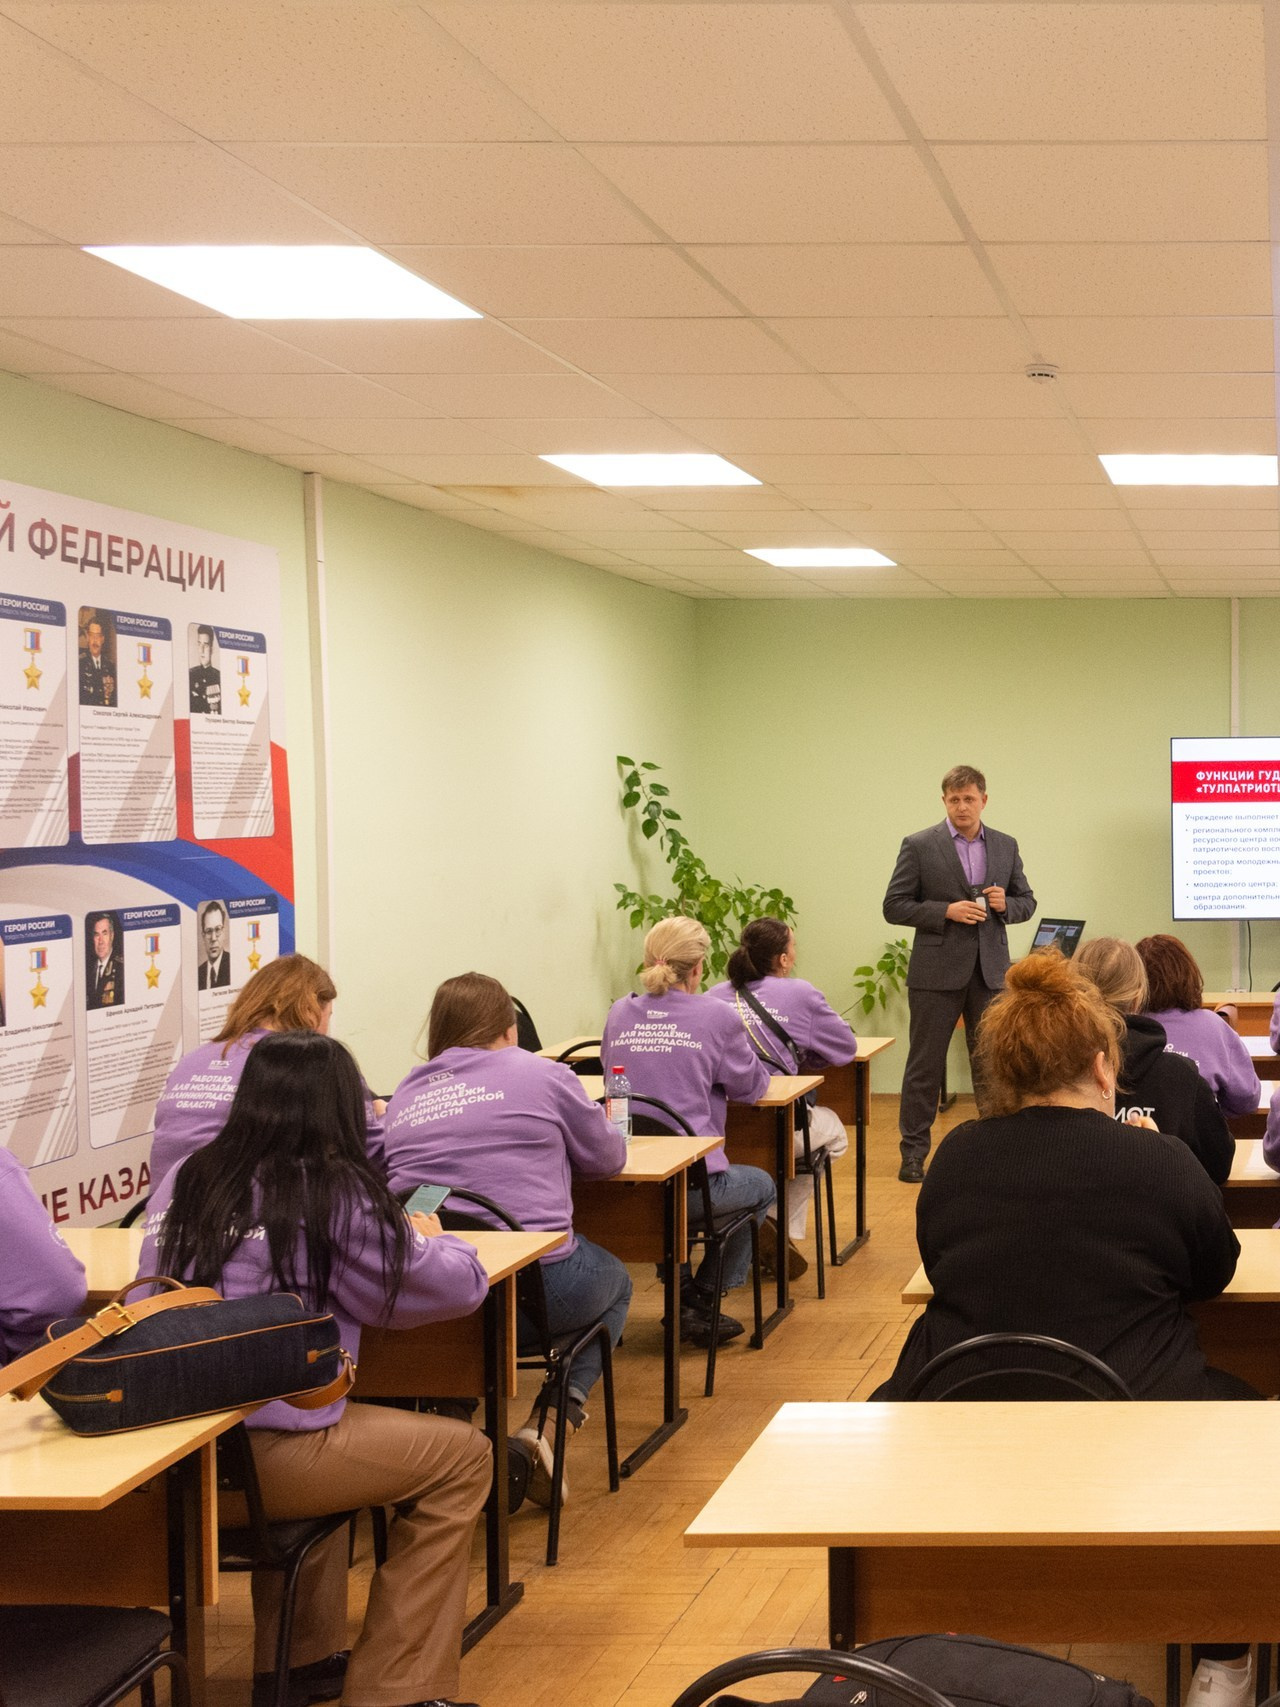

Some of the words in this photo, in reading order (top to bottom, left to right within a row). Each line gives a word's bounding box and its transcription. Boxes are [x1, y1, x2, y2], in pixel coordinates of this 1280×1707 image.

[28, 518, 225, 592] ФЕДЕРАЦИИ
[22, 601, 50, 612] РОССИИ
[117, 615, 136, 625] ГЕРОИ
[136, 618, 158, 628] РОССИИ
[1196, 771, 1254, 782] ФУНКЦИИ
[1193, 836, 1238, 844] ресурсного
[1193, 858, 1235, 866] оператора
[124, 911, 143, 920] ГЕРОИ
[143, 909, 166, 918] РОССИИ
[5, 923, 27, 933] ГЕРОИ
[28, 920, 56, 931] РОССИИ
[634, 1023, 677, 1031] РАБОТАЮ
[614, 1038, 703, 1050] КАЛИНИНГРАДСКОЙ
[630, 1045, 672, 1053] ОБЛАСТИ
[191, 1074, 232, 1083] РАБОТАЮ
[172, 1083, 191, 1091] ДЛЯ
[414, 1082, 467, 1103] РАБОТАЮ
[176, 1100, 217, 1110] ОБЛАСТИ
[391, 1090, 505, 1129] КАЛИНИНГРАДСКОЙ
[397, 1105, 416, 1118] ДЛЯ
[410, 1107, 464, 1127] ОБЛАСТИ
